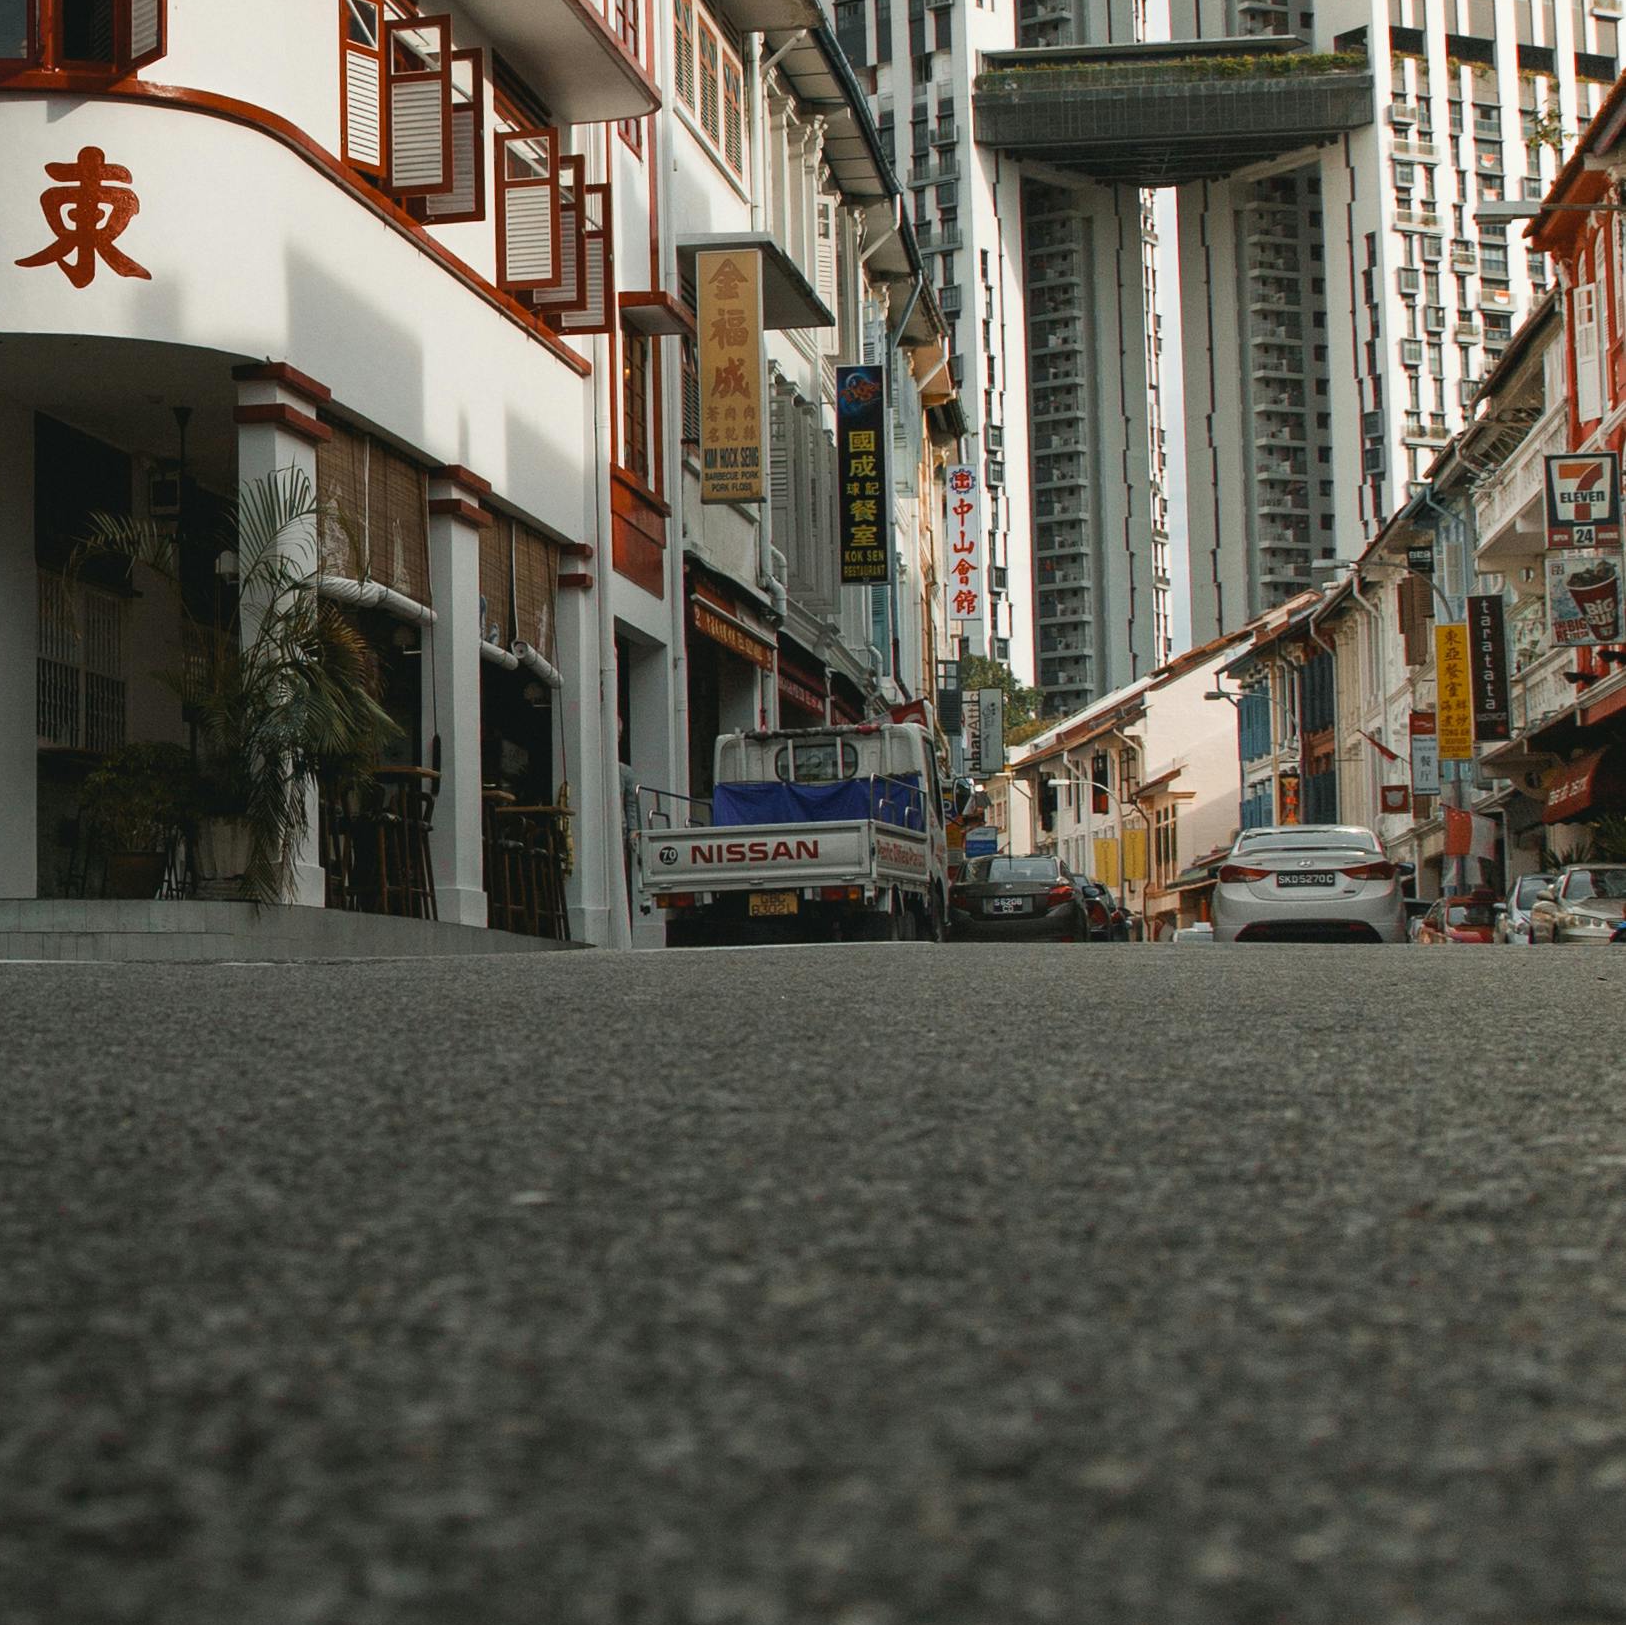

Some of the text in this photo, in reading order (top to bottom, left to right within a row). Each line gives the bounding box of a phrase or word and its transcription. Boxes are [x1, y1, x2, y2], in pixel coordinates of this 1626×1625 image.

[1576, 529, 1593, 543] 24
[845, 549, 884, 562] KOK SEN
[952, 498, 978, 615] 中山會館
[843, 565, 886, 576] RESTAURANT
[1480, 600, 1496, 710] taratata
[661, 849, 677, 860] 70
[691, 840, 819, 864] NISSAN
